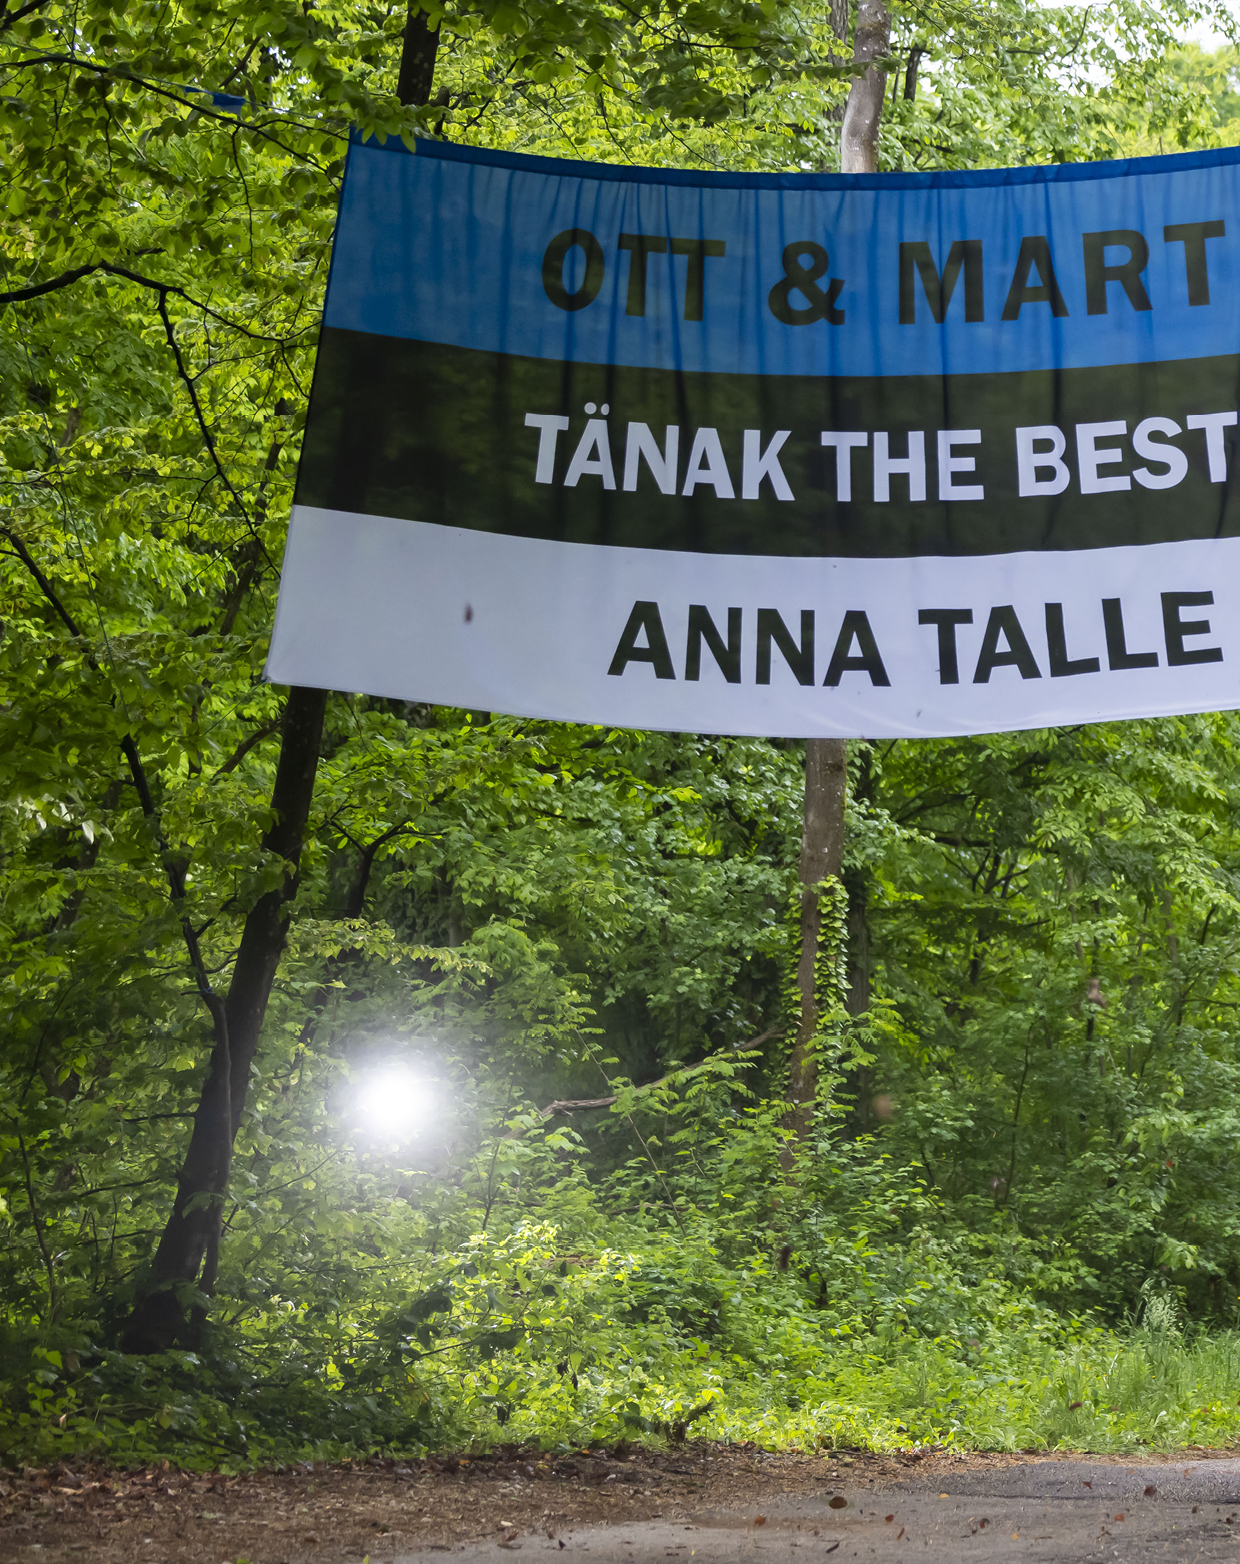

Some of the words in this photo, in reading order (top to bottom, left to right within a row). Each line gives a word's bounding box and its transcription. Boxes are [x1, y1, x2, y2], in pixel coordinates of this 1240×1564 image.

[541, 228, 727, 322] OTT
[767, 240, 846, 327] &
[524, 402, 796, 501] TÄNAK
[820, 428, 985, 503] THE
[606, 600, 892, 688] ANNA
